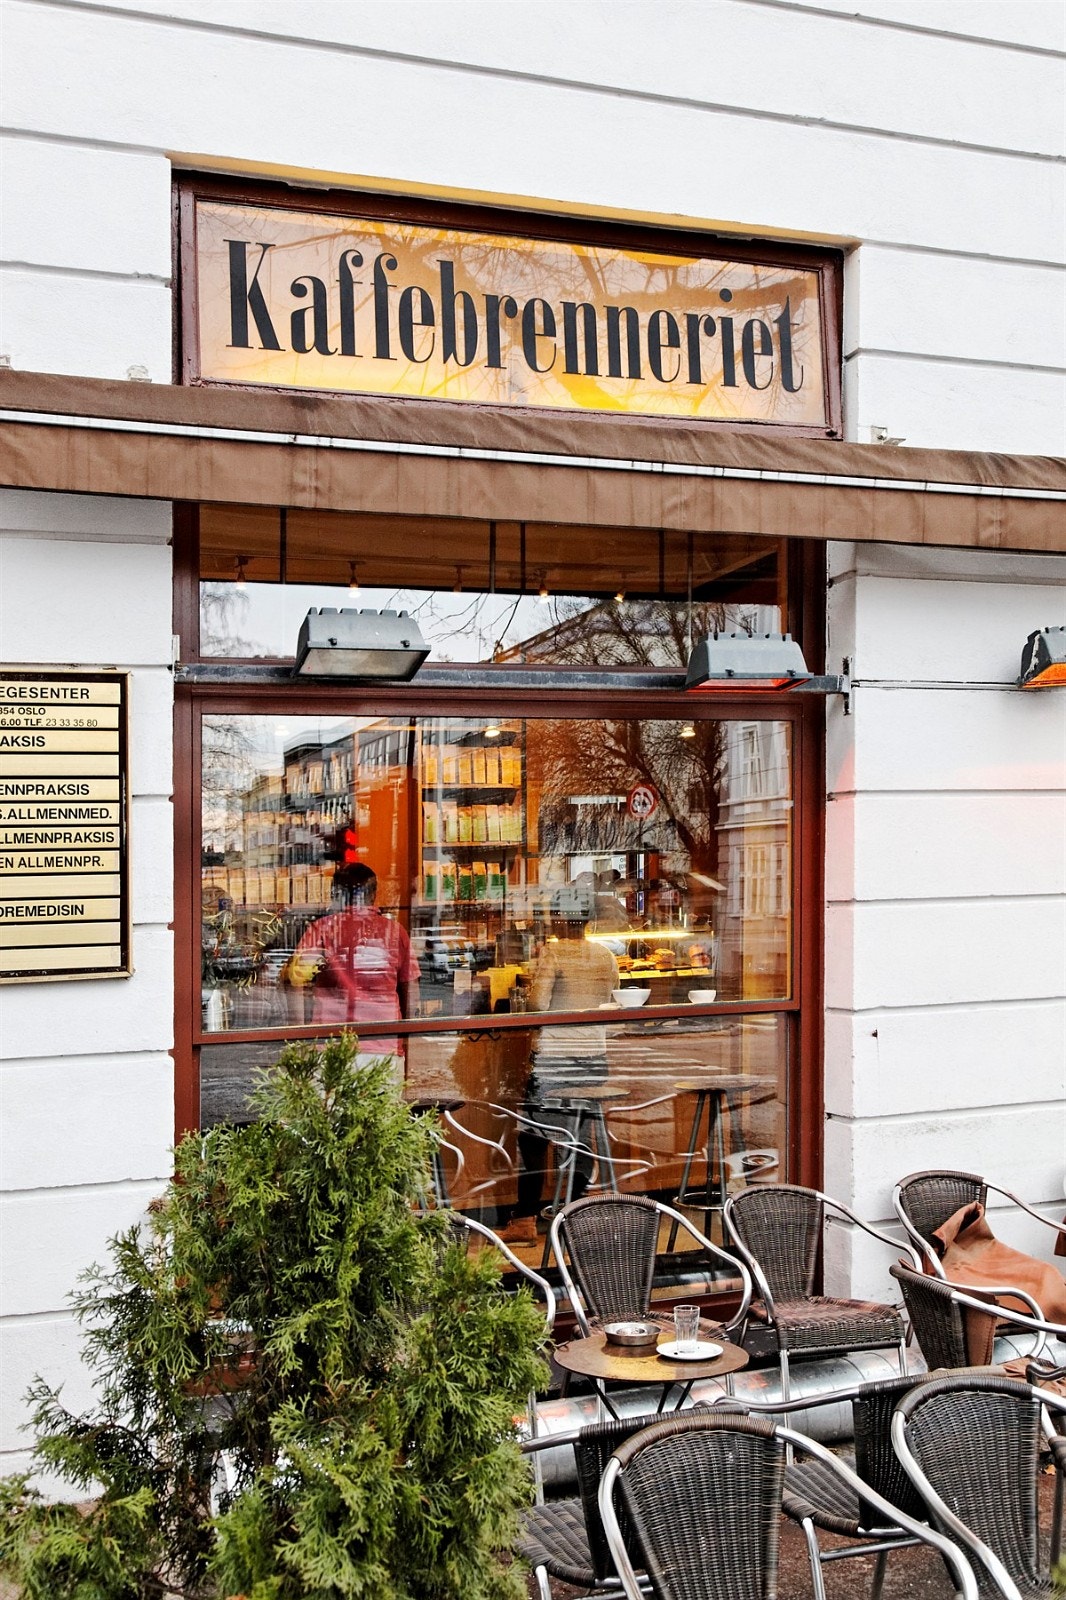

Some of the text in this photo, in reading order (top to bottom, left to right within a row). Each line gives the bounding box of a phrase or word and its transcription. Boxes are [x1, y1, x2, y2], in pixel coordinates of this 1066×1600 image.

[222, 238, 805, 394] Kaffebrenneriet
[17, 706, 46, 715] OSLO
[45, 718, 57, 728] 23
[58, 718, 71, 728] 33
[73, 718, 85, 728] 35
[86, 719, 98, 728] 80
[0, 735, 46, 748] AKSIS
[17, 855, 105, 868] ALLMENNPR.
